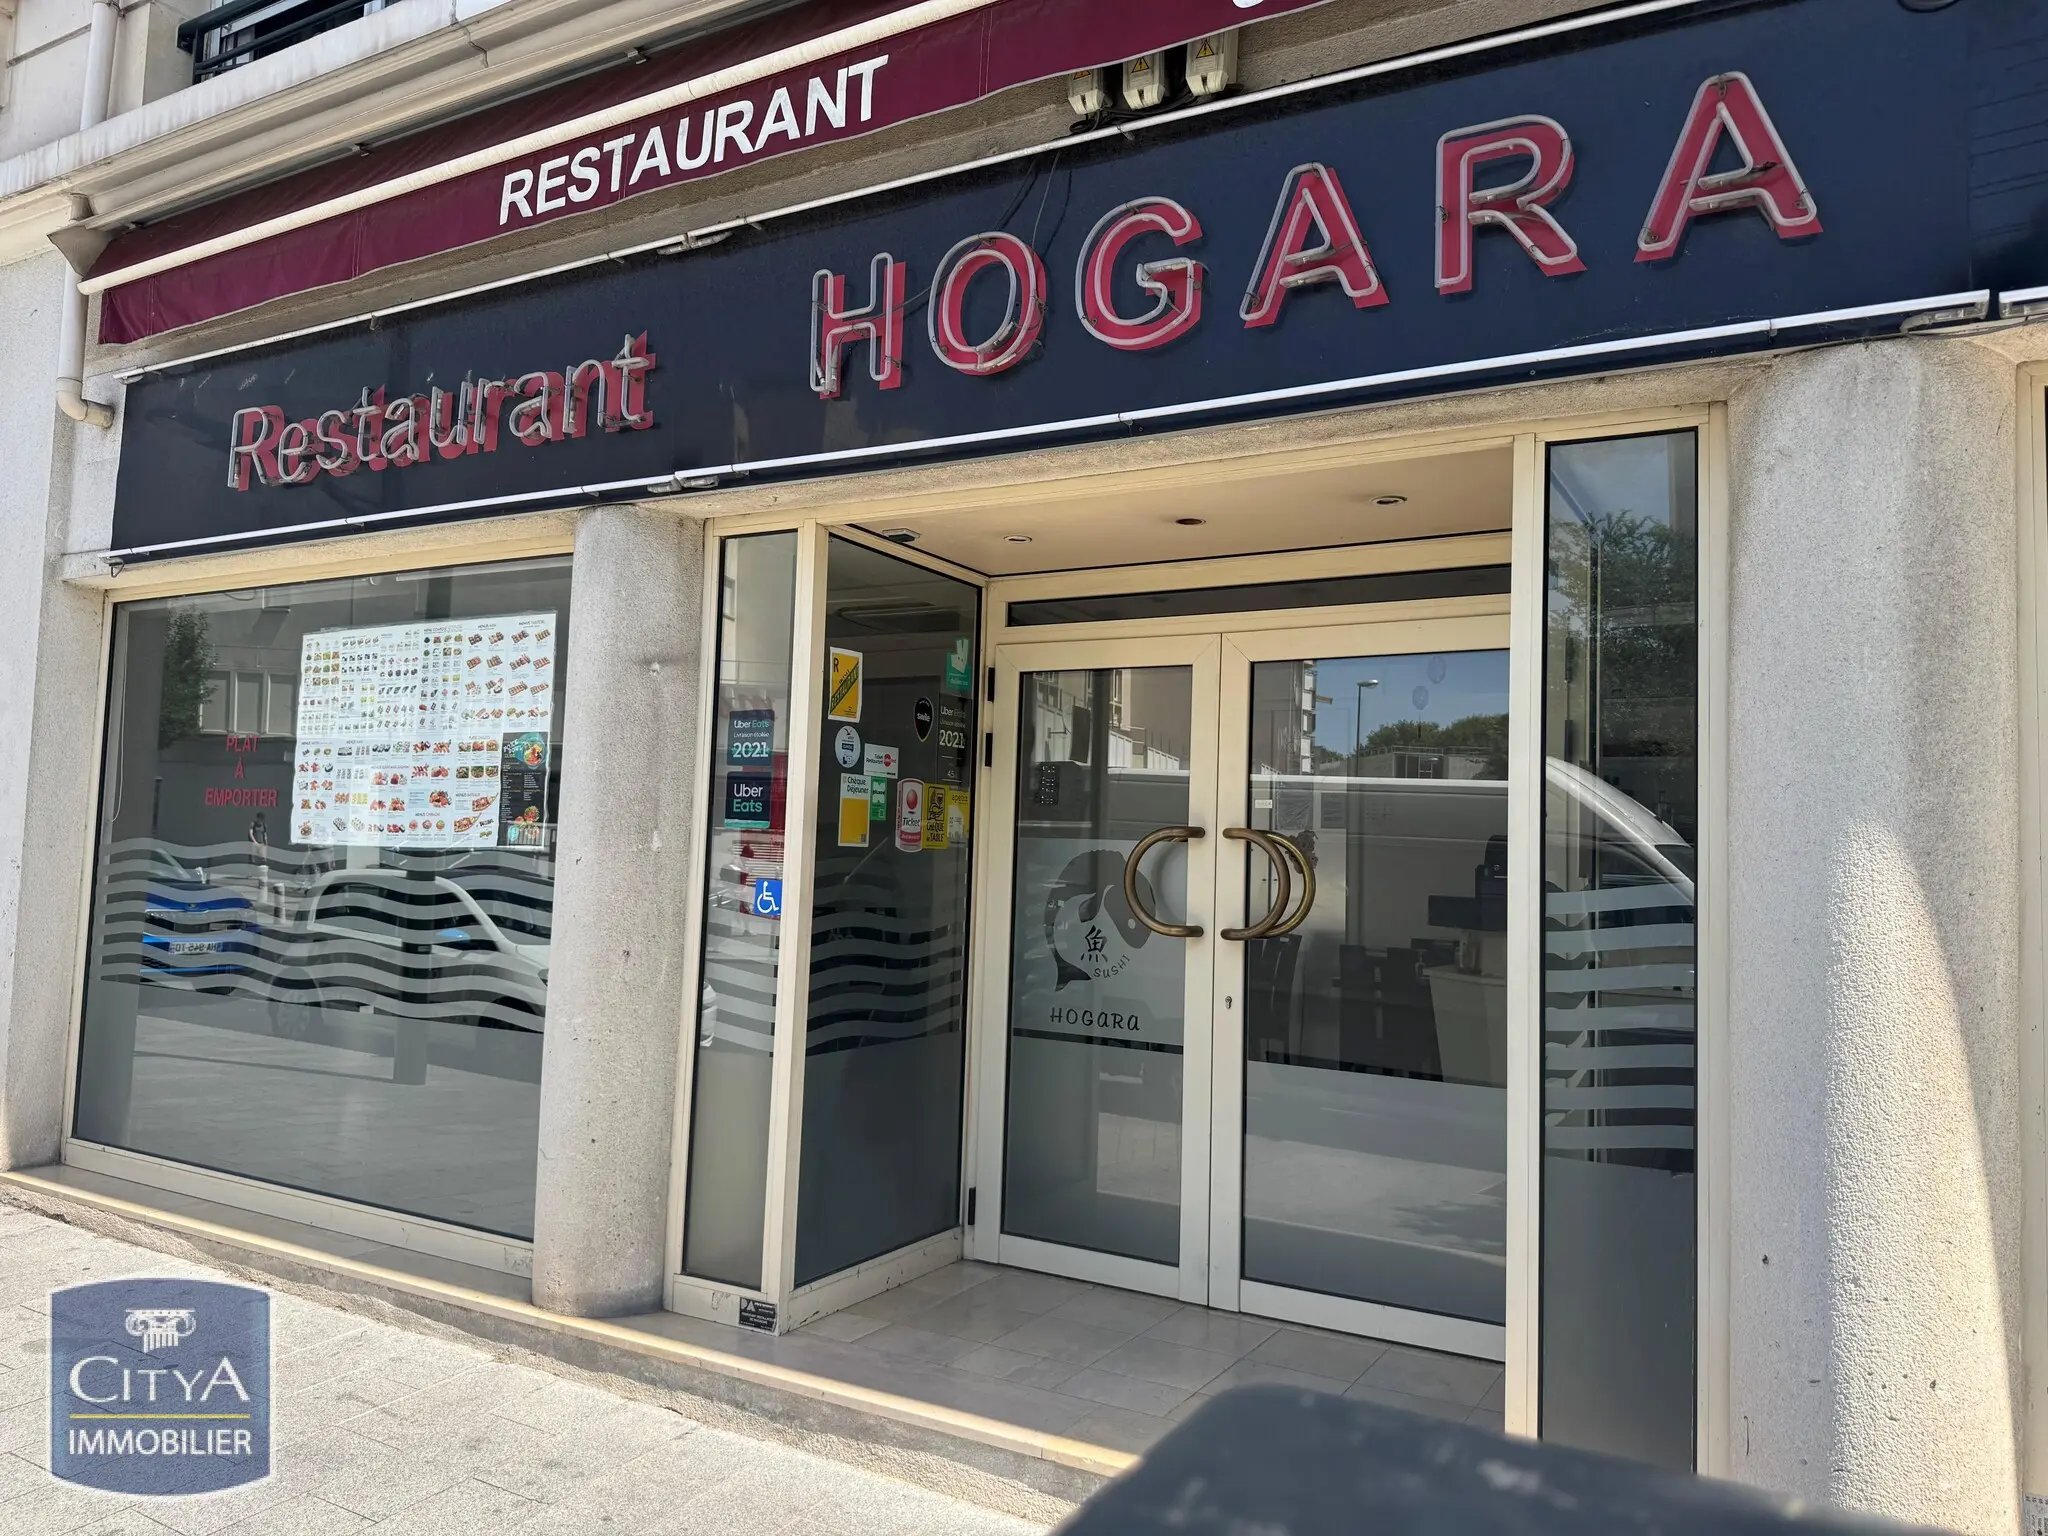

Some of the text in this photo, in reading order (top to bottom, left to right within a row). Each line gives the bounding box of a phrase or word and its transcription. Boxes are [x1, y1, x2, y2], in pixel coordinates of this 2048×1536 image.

[499, 54, 889, 226] RESTAURANT
[227, 70, 1824, 492] Restaurant HOGARA
[940, 705, 954, 717] Uber
[733, 719, 770, 729] Uber Eats
[225, 734, 260, 753] PLAT
[939, 729, 965, 749] 2021
[733, 741, 769, 758] 2021
[847, 776, 867, 786] Chèque
[204, 786, 279, 808] EMPORTER
[733, 783, 764, 797] Uber
[847, 784, 869, 795] Déjeuner
[733, 798, 763, 812] Eats
[903, 817, 920, 827] Ticket
[1080, 924, 1108, 963] 魚
